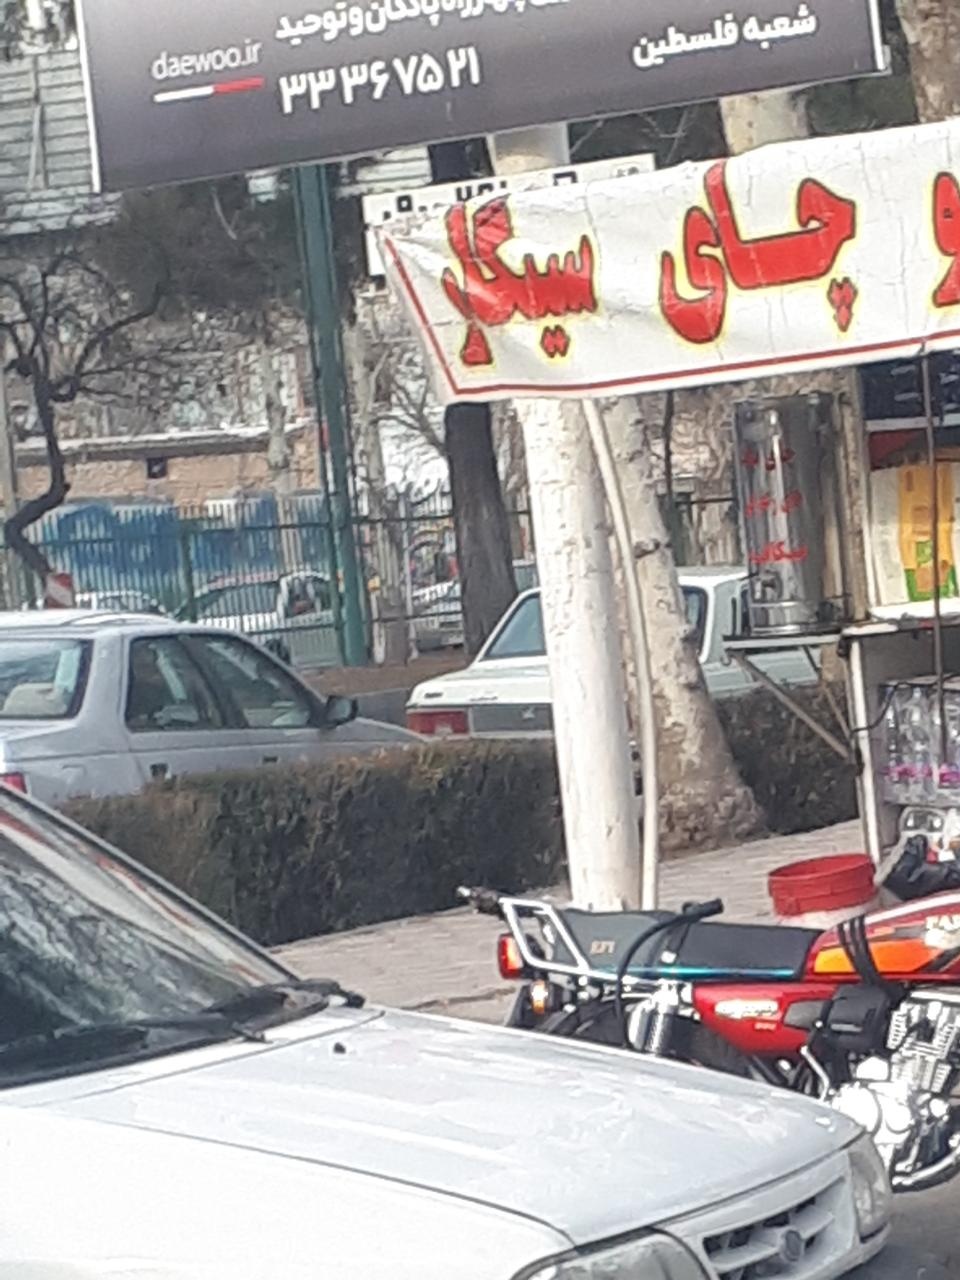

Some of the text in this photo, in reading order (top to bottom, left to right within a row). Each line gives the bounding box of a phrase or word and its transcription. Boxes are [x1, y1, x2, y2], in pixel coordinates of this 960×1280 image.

[151, 38, 263, 80] daewoo.ir
[632, 3, 817, 68] شعبه فلسطین
[440, 194, 599, 368] سیگار
[658, 157, 860, 344] چای
